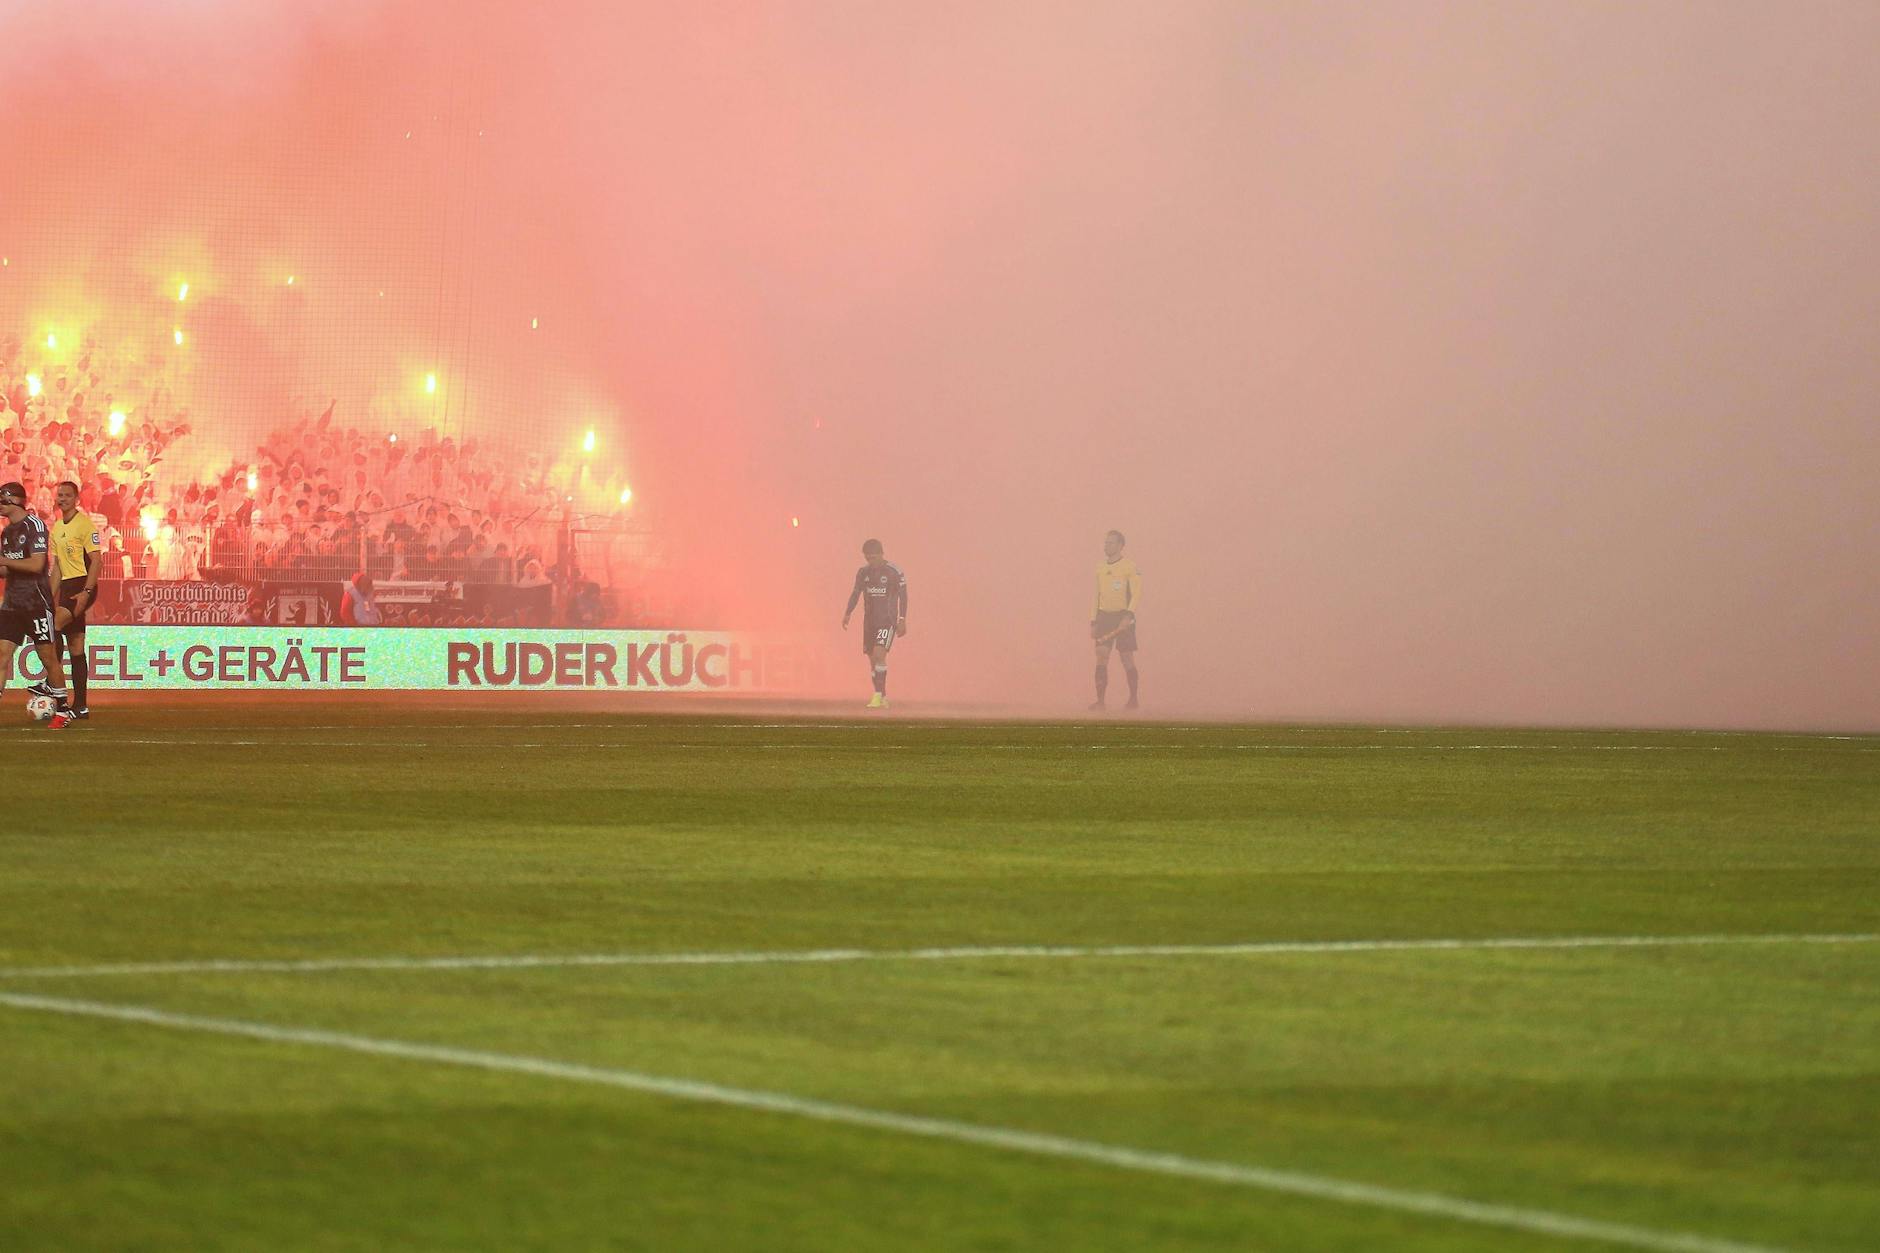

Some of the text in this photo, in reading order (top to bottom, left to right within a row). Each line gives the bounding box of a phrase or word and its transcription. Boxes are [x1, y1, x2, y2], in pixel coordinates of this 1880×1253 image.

[33, 618, 49, 634] 13
[877, 629, 888, 639] 20
[447, 642, 618, 686] RUDER
